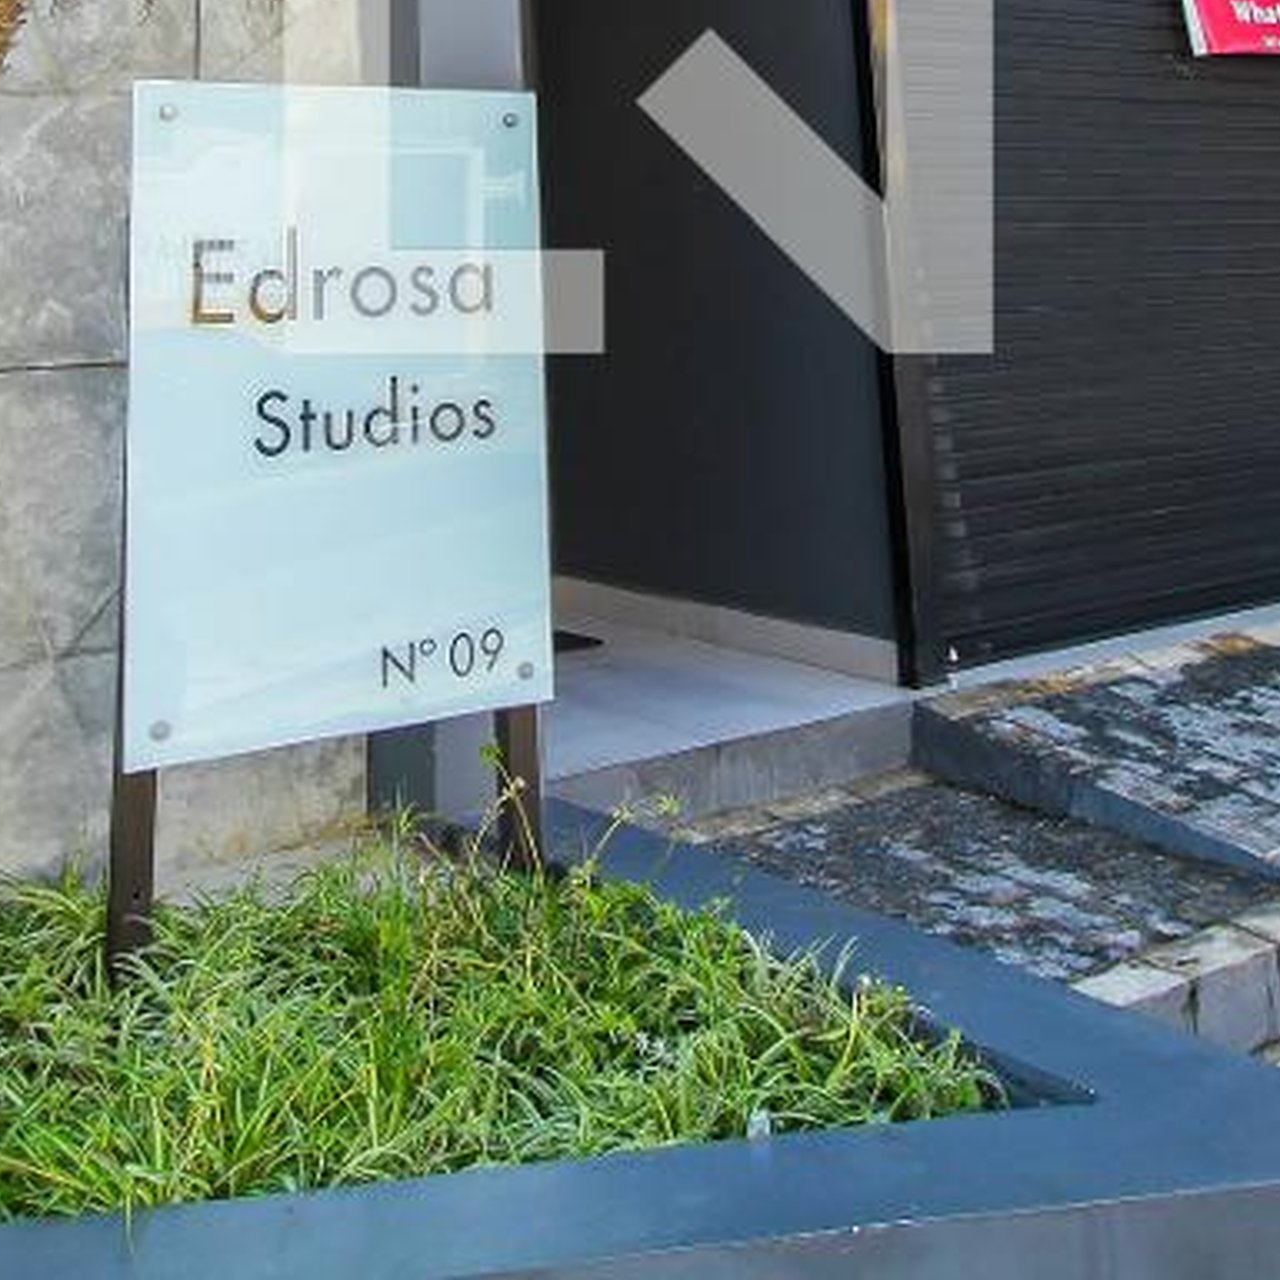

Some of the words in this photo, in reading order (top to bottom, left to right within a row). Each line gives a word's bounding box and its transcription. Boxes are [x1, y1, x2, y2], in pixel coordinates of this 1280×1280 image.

[190, 227, 495, 325] Edrosa
[252, 375, 498, 458] Studios
[448, 627, 506, 678] 09
